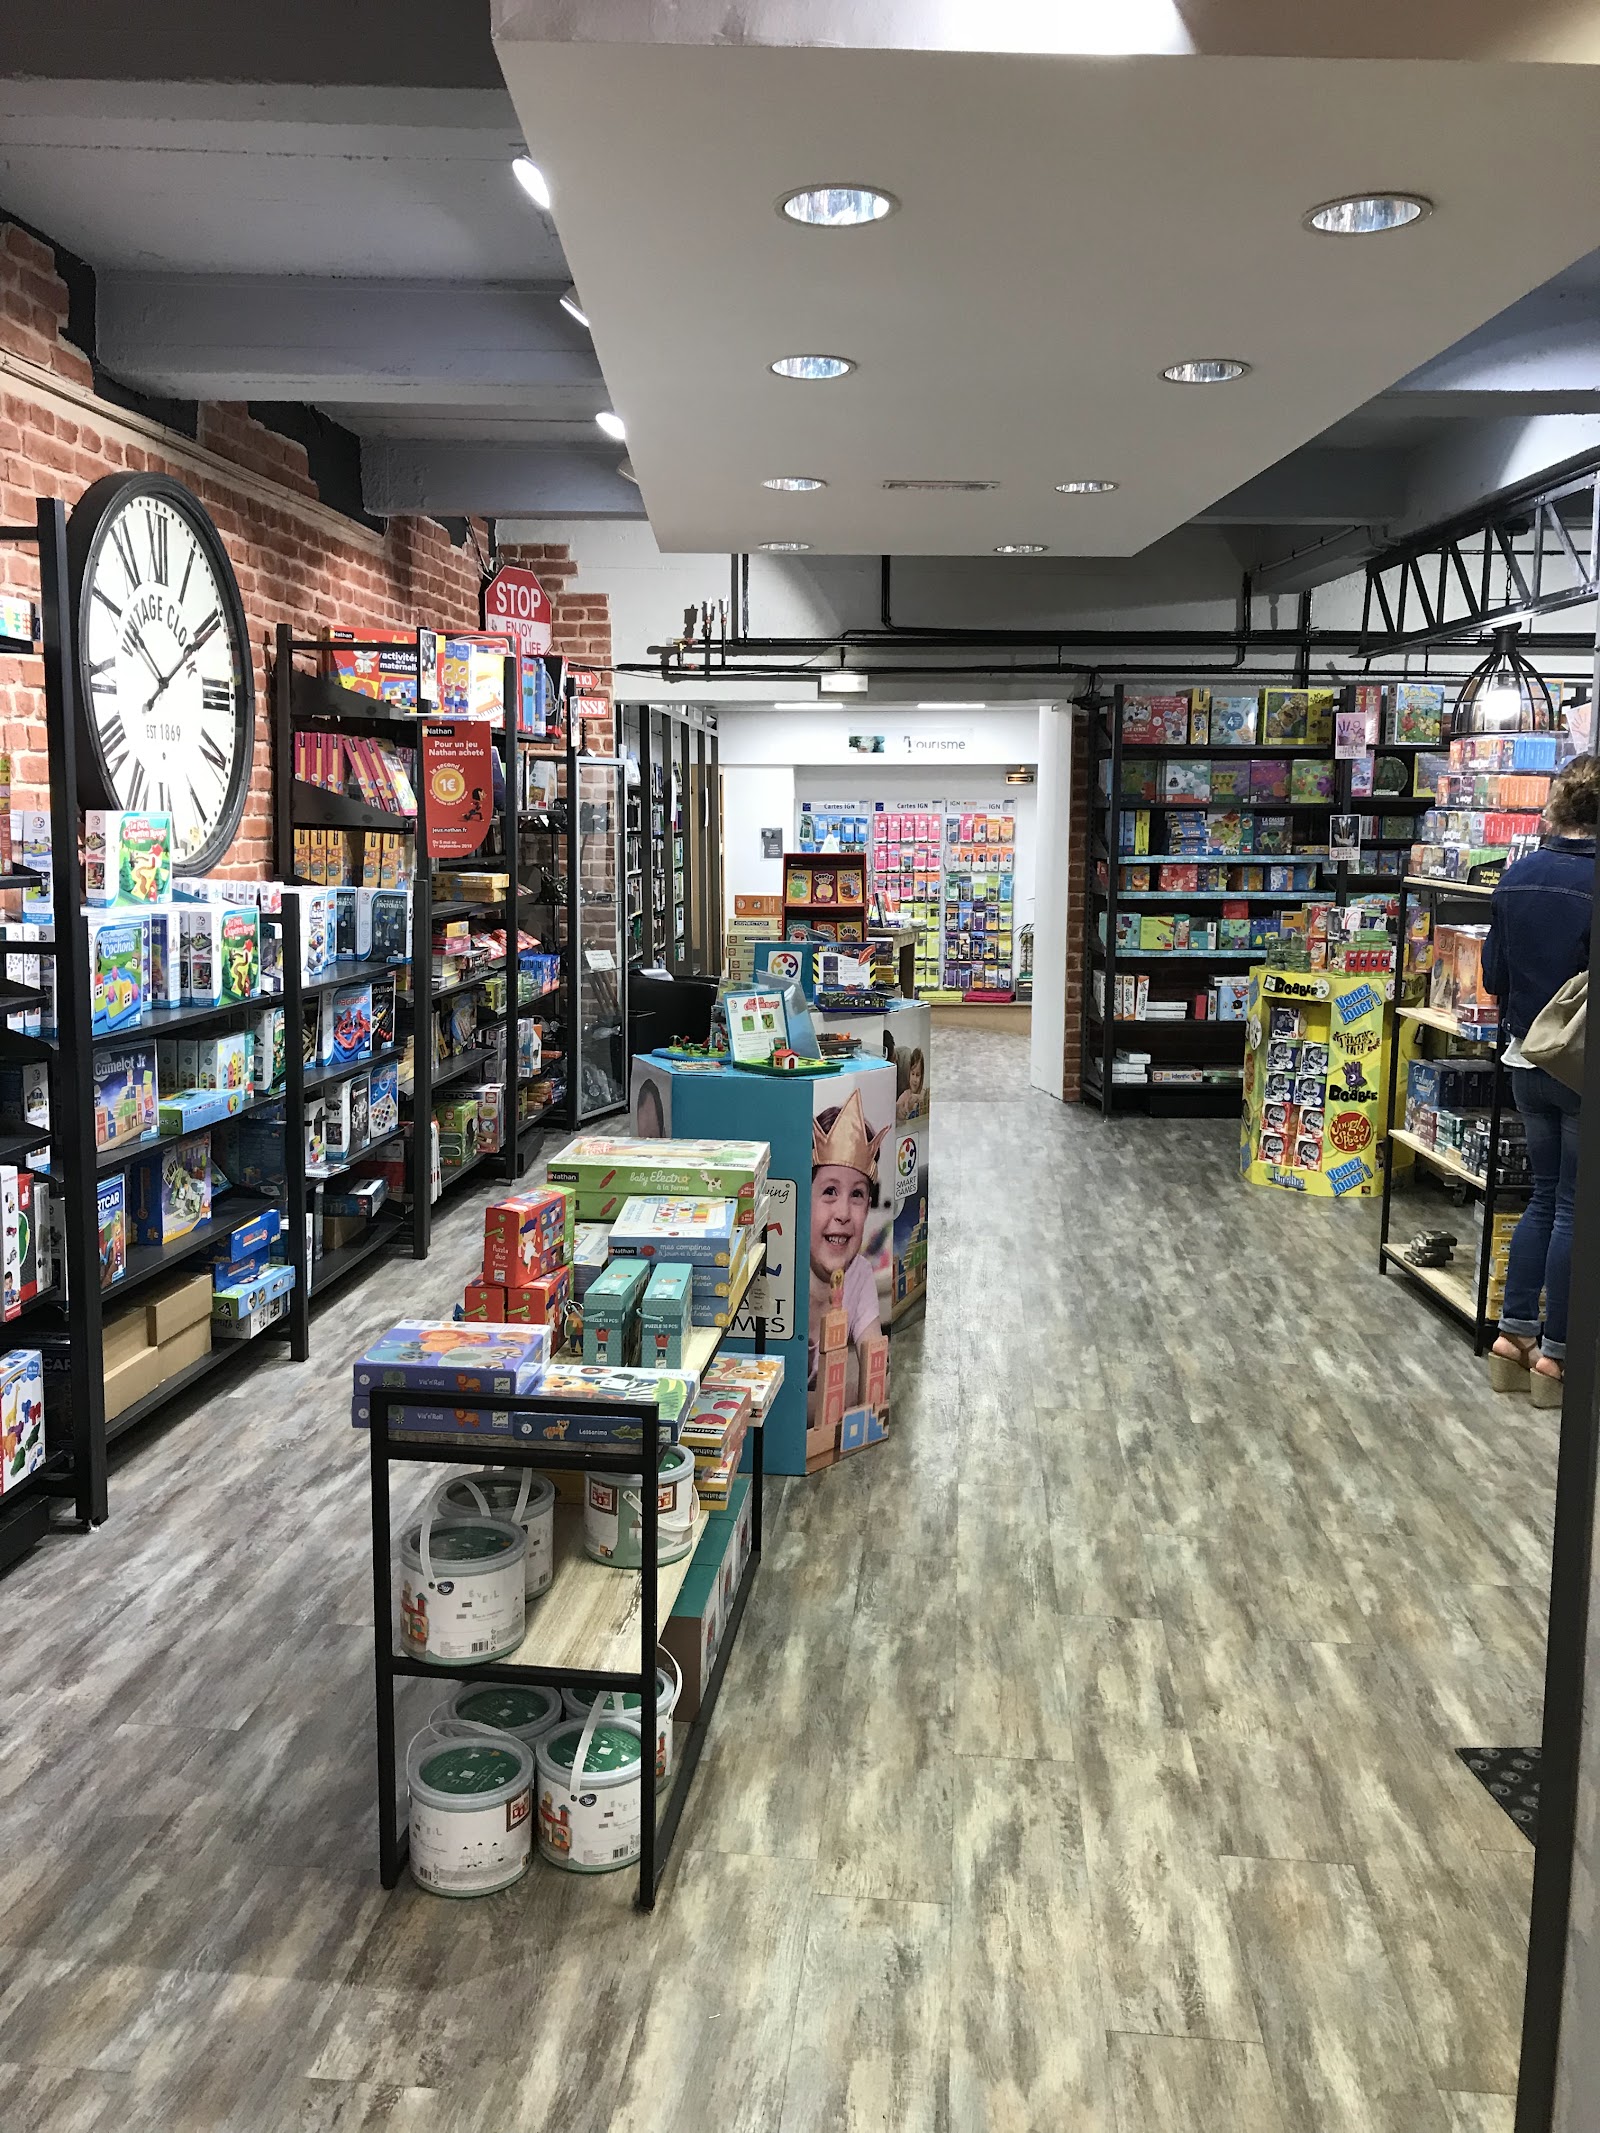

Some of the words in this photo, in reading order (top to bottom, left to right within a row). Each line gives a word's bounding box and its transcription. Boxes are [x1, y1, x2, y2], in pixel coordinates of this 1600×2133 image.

[496, 581, 541, 618] STOP
[505, 620, 533, 638] ENJOY
[166, 603, 198, 680] CLOK
[524, 641, 542, 656] LIFE
[581, 675, 593, 685] ICI
[577, 699, 608, 715] ISSE
[146, 724, 157, 740] EST
[159, 723, 181, 742] 1869
[426, 727, 453, 736] Nathan
[434, 740, 453, 748] Pour
[465, 740, 478, 750] jeu
[903, 735, 966, 753] Tourisme
[428, 748, 457, 756] Nathan
[458, 748, 485, 756] acheté
[436, 762, 460, 770] second
[439, 778, 457, 792] 1€
[103, 940, 135, 959] Cochons
[1333, 983, 1372, 1010] Venez
[95, 1056, 135, 1076] Camelot
[136, 1052, 147, 1069] Jr
[1328, 1084, 1378, 1103] DOBBLE
[1333, 1125, 1370, 1149] Speed
[630, 1173, 649, 1183] baby
[649, 1170, 691, 1183] Electro
[1325, 1156, 1362, 1182] Venez
[551, 1173, 577, 1181] Nathan
[896, 1175, 917, 1190] SMART
[656, 1183, 662, 1191] à
[662, 1183, 669, 1191] la
[669, 1184, 690, 1192] ferme
[896, 1184, 917, 1198] GAMES
[97, 1190, 120, 1211] RTCAR
[492, 1243, 509, 1254] Puzzle
[675, 1243, 711, 1252] comptines
[494, 1253, 506, 1261] duo
[730, 1316, 786, 1334] MES
